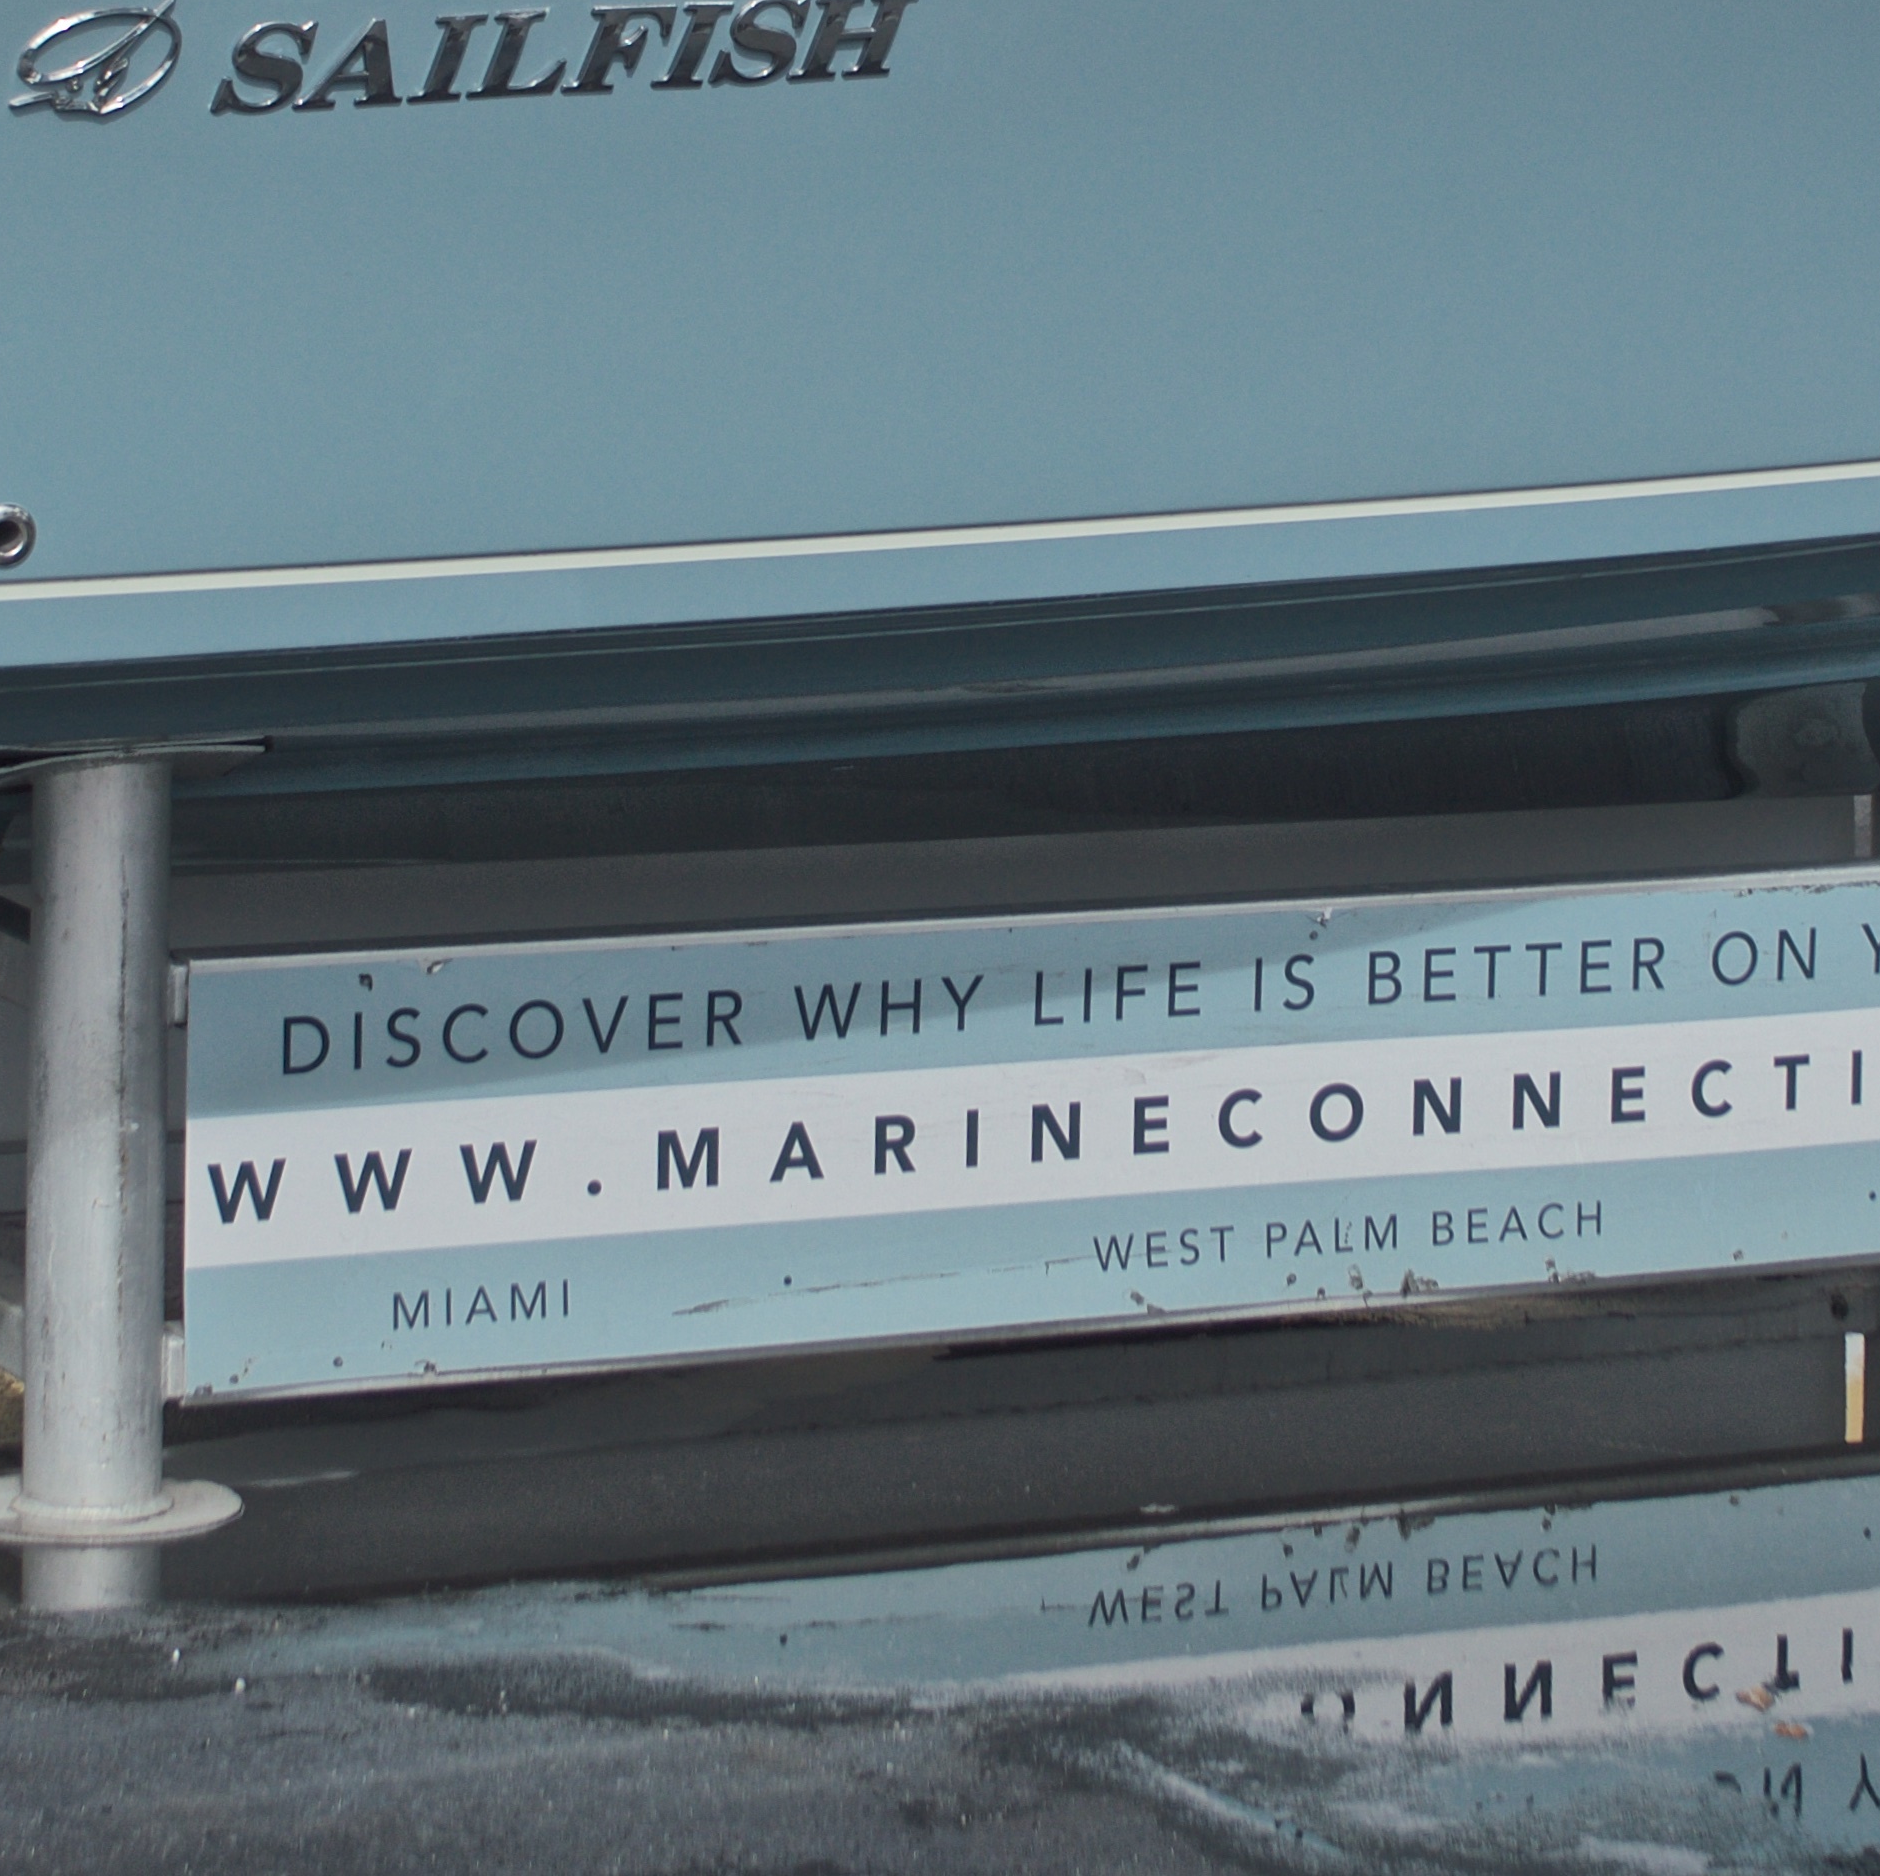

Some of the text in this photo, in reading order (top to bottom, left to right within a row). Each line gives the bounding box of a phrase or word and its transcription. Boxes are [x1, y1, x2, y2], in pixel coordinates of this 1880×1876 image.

[283, 987, 745, 1077] DISCOVER
[794, 972, 984, 1041] WHY
[1033, 960, 1204, 1028] LIFE
[1252, 952, 1317, 1012] IS
[1367, 936, 1667, 1007] BETTER
[1710, 925, 1818, 988] ON
[1093, 1201, 1605, 1273] WEST PALM BEACH
[391, 1280, 572, 1331] MIAMI
